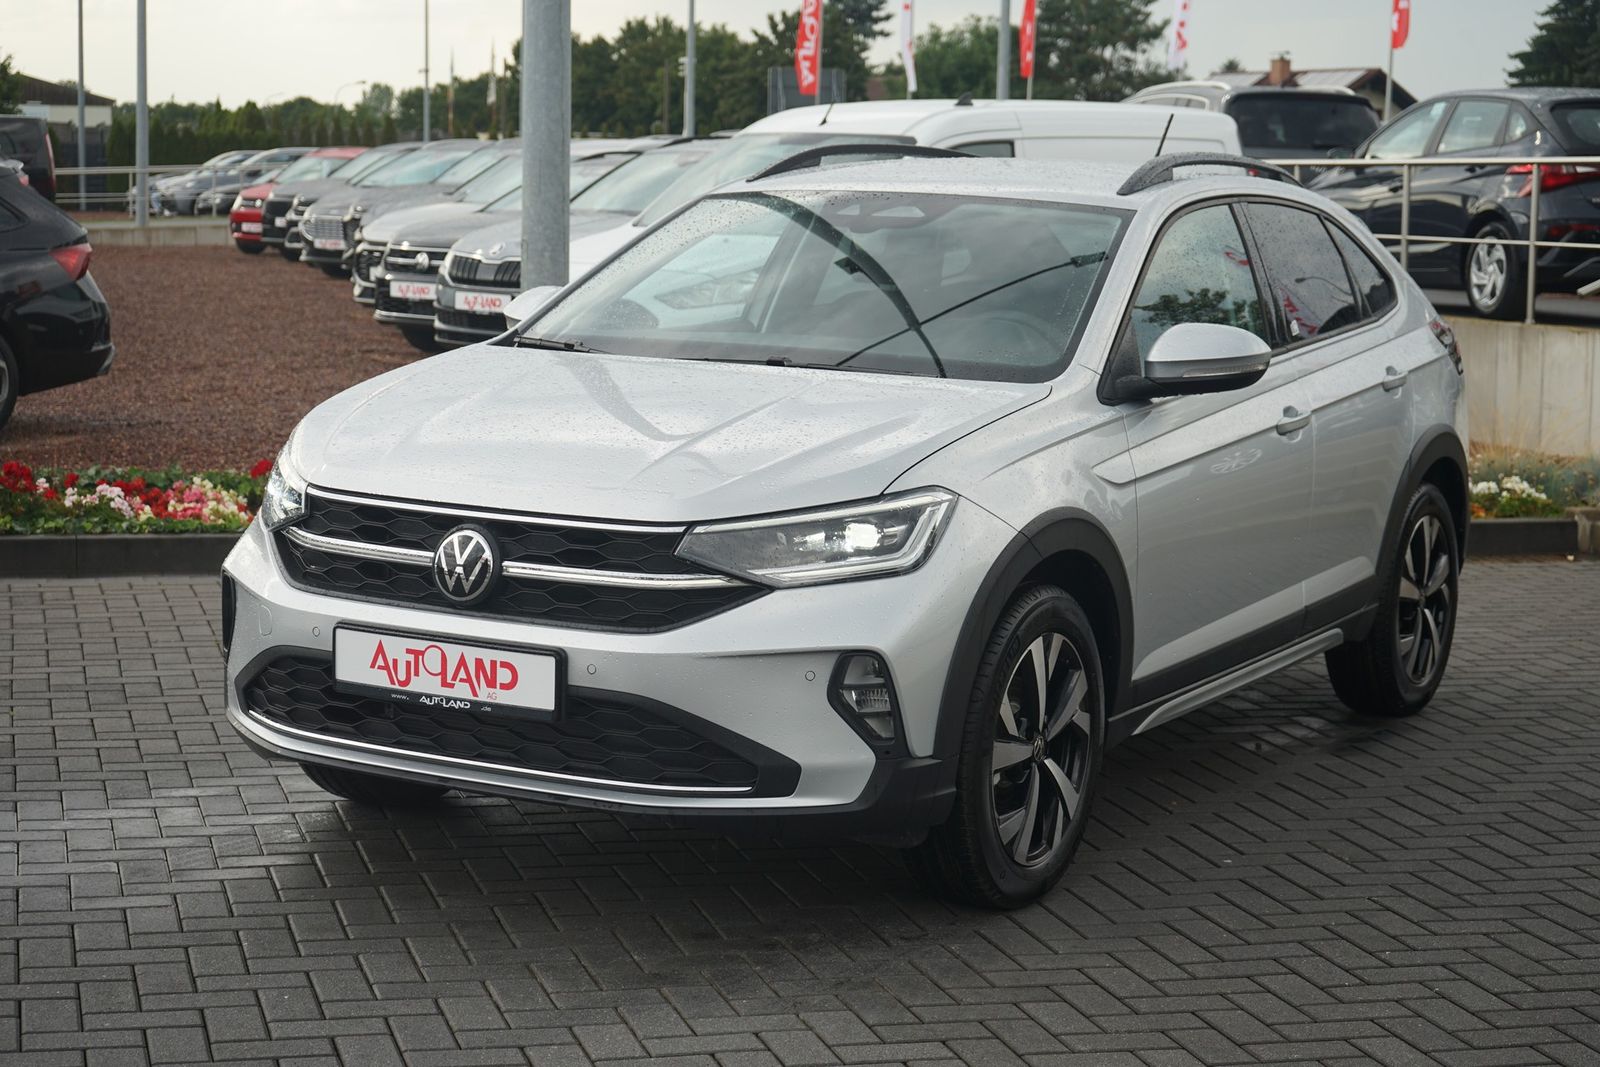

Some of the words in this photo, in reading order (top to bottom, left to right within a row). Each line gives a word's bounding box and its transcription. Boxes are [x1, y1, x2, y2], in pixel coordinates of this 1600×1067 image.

[369, 639, 519, 698] AUTOLAND
[419, 695, 471, 709] AUTOLAND
[486, 692, 498, 700] AG
